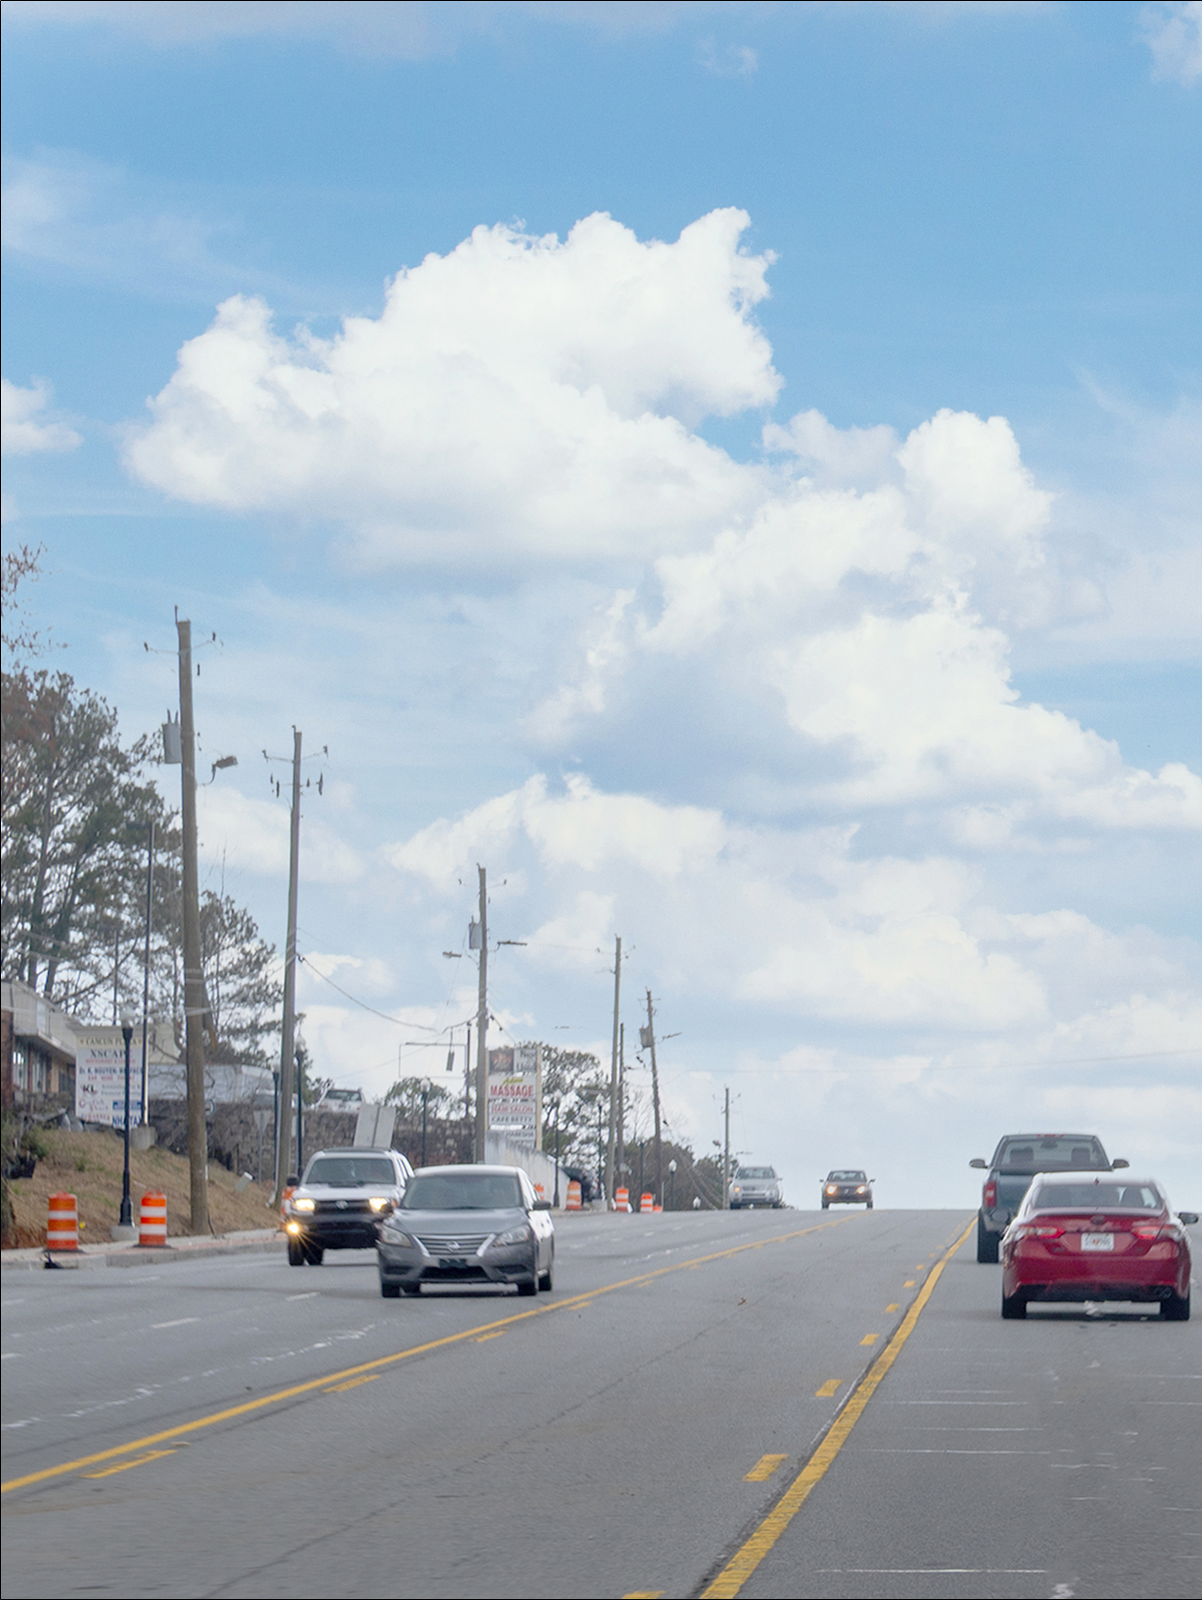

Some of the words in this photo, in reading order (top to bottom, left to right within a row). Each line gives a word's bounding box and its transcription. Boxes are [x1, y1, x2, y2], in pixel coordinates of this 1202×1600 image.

[115, 1038, 138, 1046] PLA
[90, 1049, 131, 1058] XSCAP
[490, 1085, 533, 1096] MASSAGE
[510, 1104, 533, 1112] SALON
